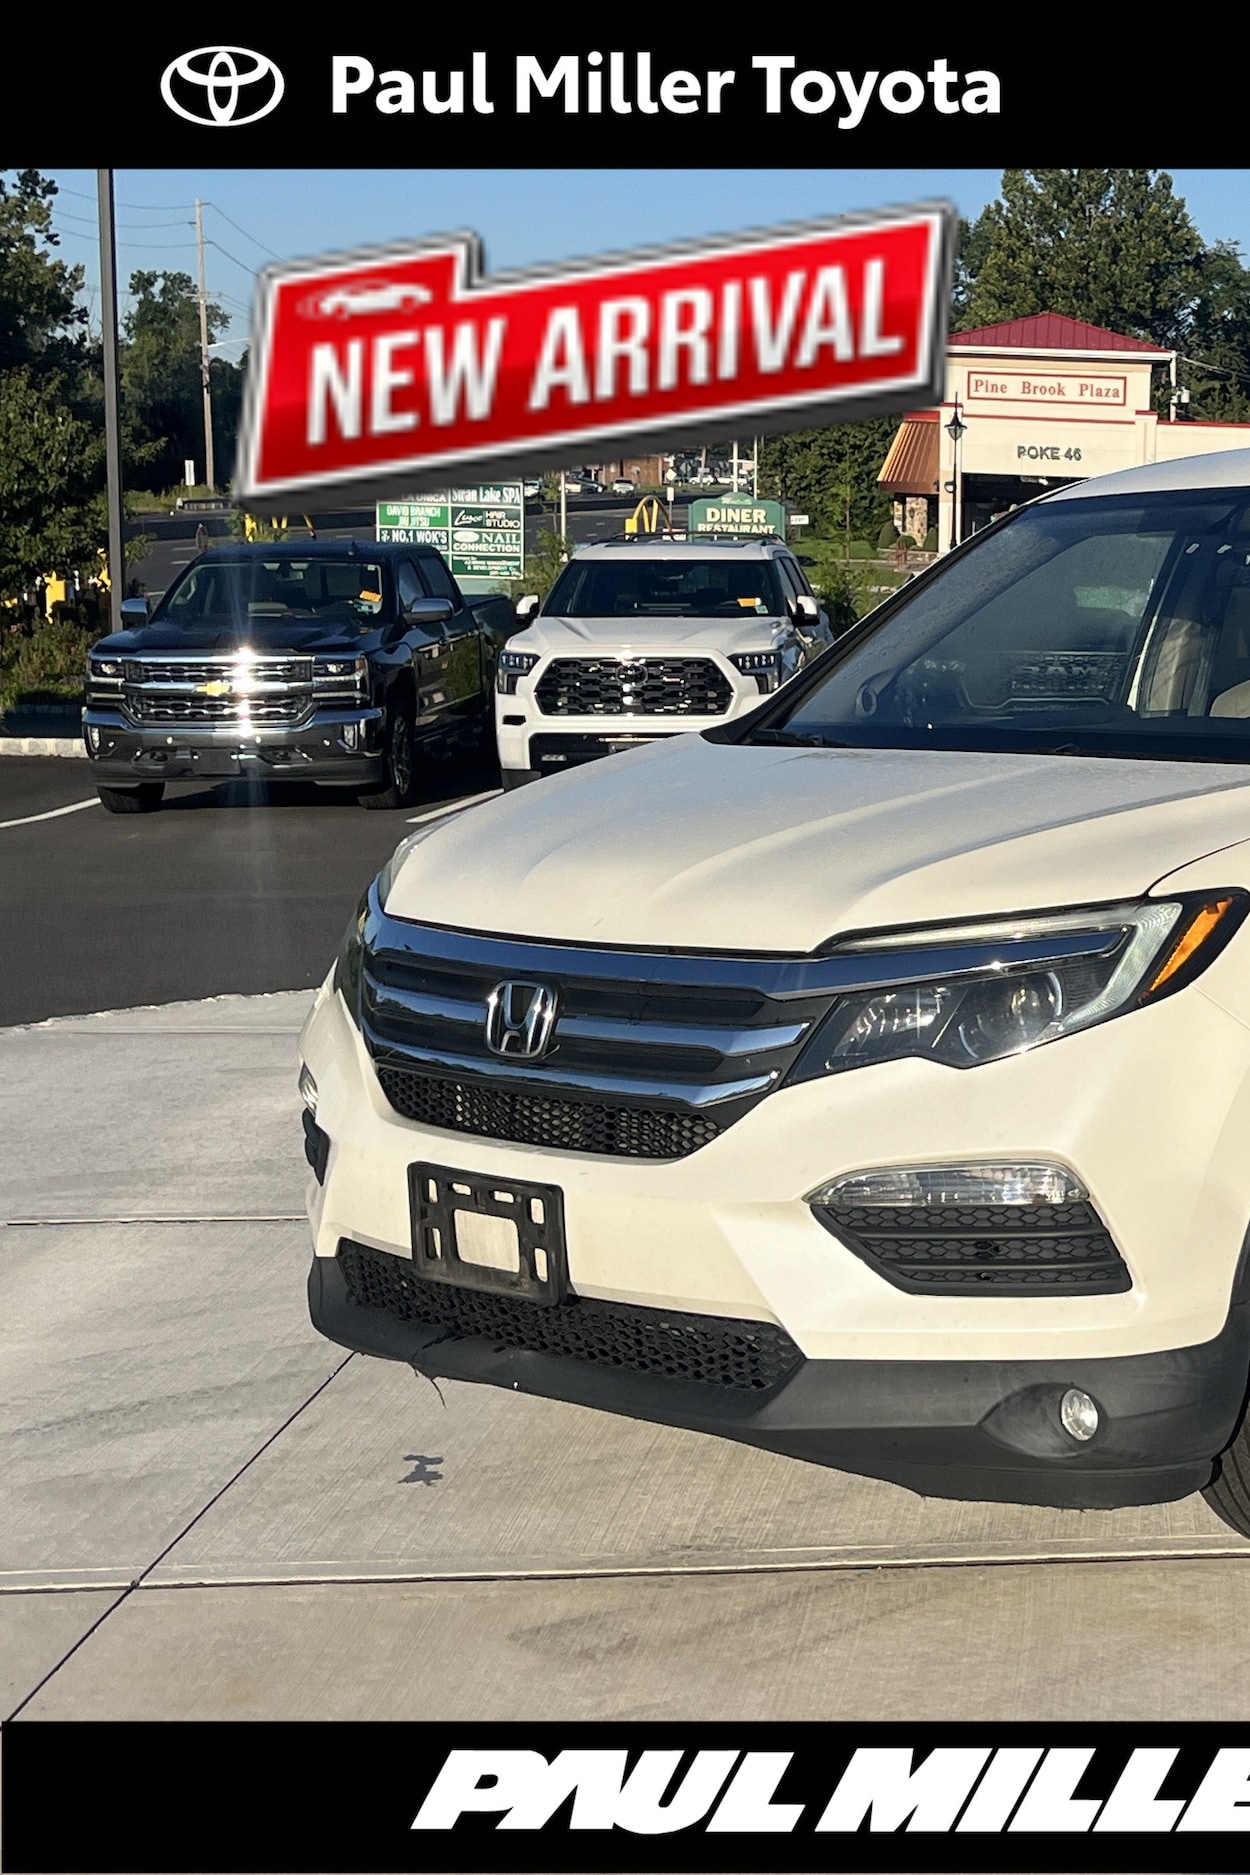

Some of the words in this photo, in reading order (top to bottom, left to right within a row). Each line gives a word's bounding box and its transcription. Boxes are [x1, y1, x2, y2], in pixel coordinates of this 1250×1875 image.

[974, 379, 1008, 394] Pine
[1021, 381, 1066, 396] Brook
[1079, 383, 1120, 398] Plaza
[1017, 446, 1060, 460] POKE
[1064, 447, 1082, 461] 46
[452, 488, 477, 502] Swan
[479, 486, 501, 503] Lake
[503, 487, 521, 504] SPA
[386, 505, 409, 516] DAVID
[410, 506, 441, 518] BRANCH
[485, 511, 506, 520] HAIR
[706, 507, 767, 523] DINER
[486, 519, 521, 528] STUDIO
[697, 523, 775, 535] RESTAURANT
[392, 530, 414, 543] NO.1
[416, 530, 448, 543] WOK'S
[481, 533, 521, 544] NAIL
[453, 543, 520, 553] CONNECTION
